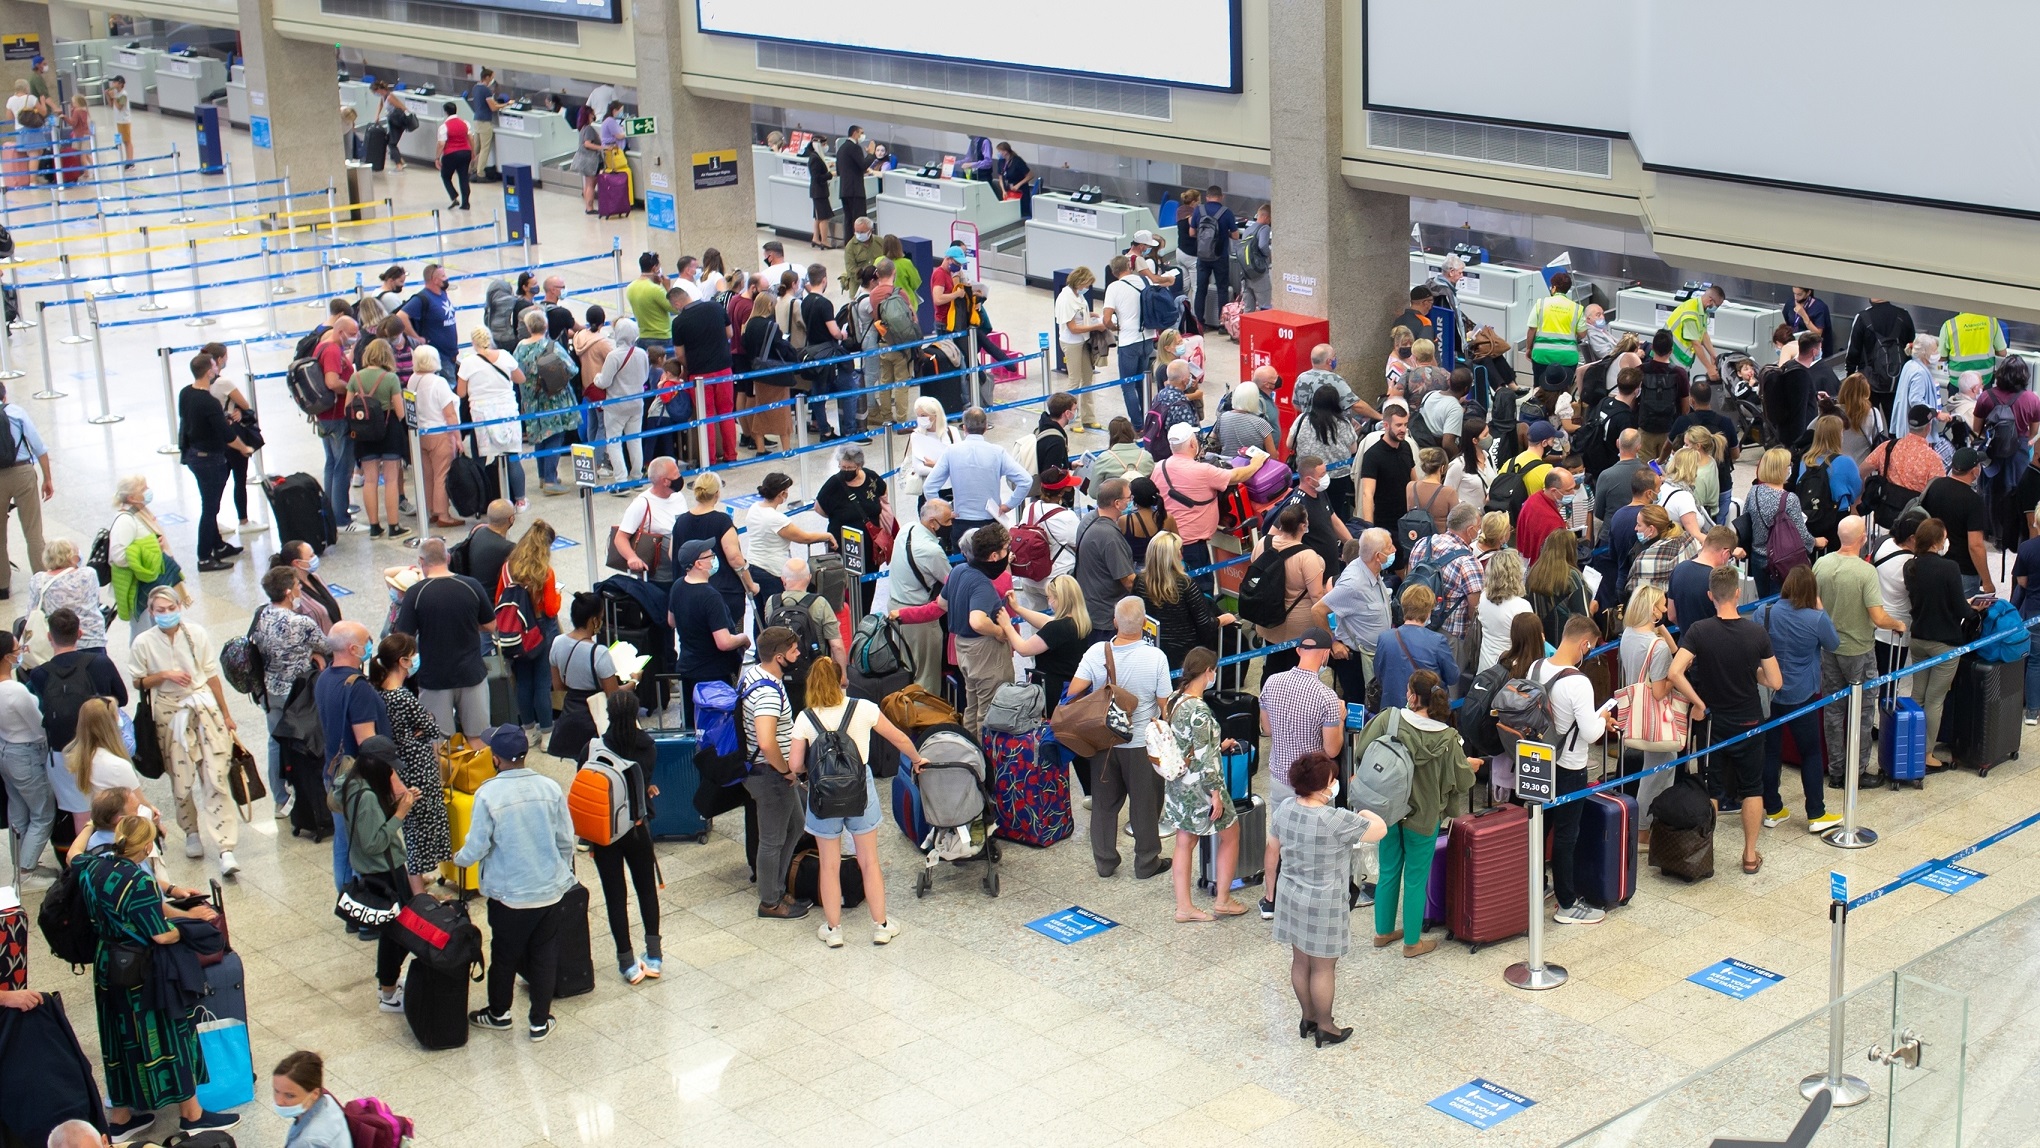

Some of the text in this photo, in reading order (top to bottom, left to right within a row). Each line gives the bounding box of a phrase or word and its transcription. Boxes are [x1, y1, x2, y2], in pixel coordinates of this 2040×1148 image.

[1282, 272, 1300, 283] FREE
[1278, 328, 1293, 340] 010
[582, 460, 590, 468] 22
[580, 472, 588, 480] 23
[851, 544, 859, 554] 24
[848, 557, 856, 567] 25
[1223, 566, 1244, 579] HSBC
[1522, 781, 1540, 792] 29,30
[1958, 868, 1978, 876] HERE
[1939, 876, 1960, 885] YOUR
[344, 901, 395, 926] adidas
[1077, 909, 1111, 925] WAIT HERE
[1044, 923, 1075, 937] DISTANCE
[1050, 919, 1084, 935] KEEP YOUR
[1733, 960, 1776, 978] WAIT HERE
[1706, 976, 1744, 991] DISTANCE
[1710, 972, 1752, 990] KEEP YOUR
[1482, 1082, 1526, 1103] WAIT HERE
[1448, 1101, 1488, 1120] DISTANCE
[1454, 1096, 1498, 1117] KEEP YOUR
